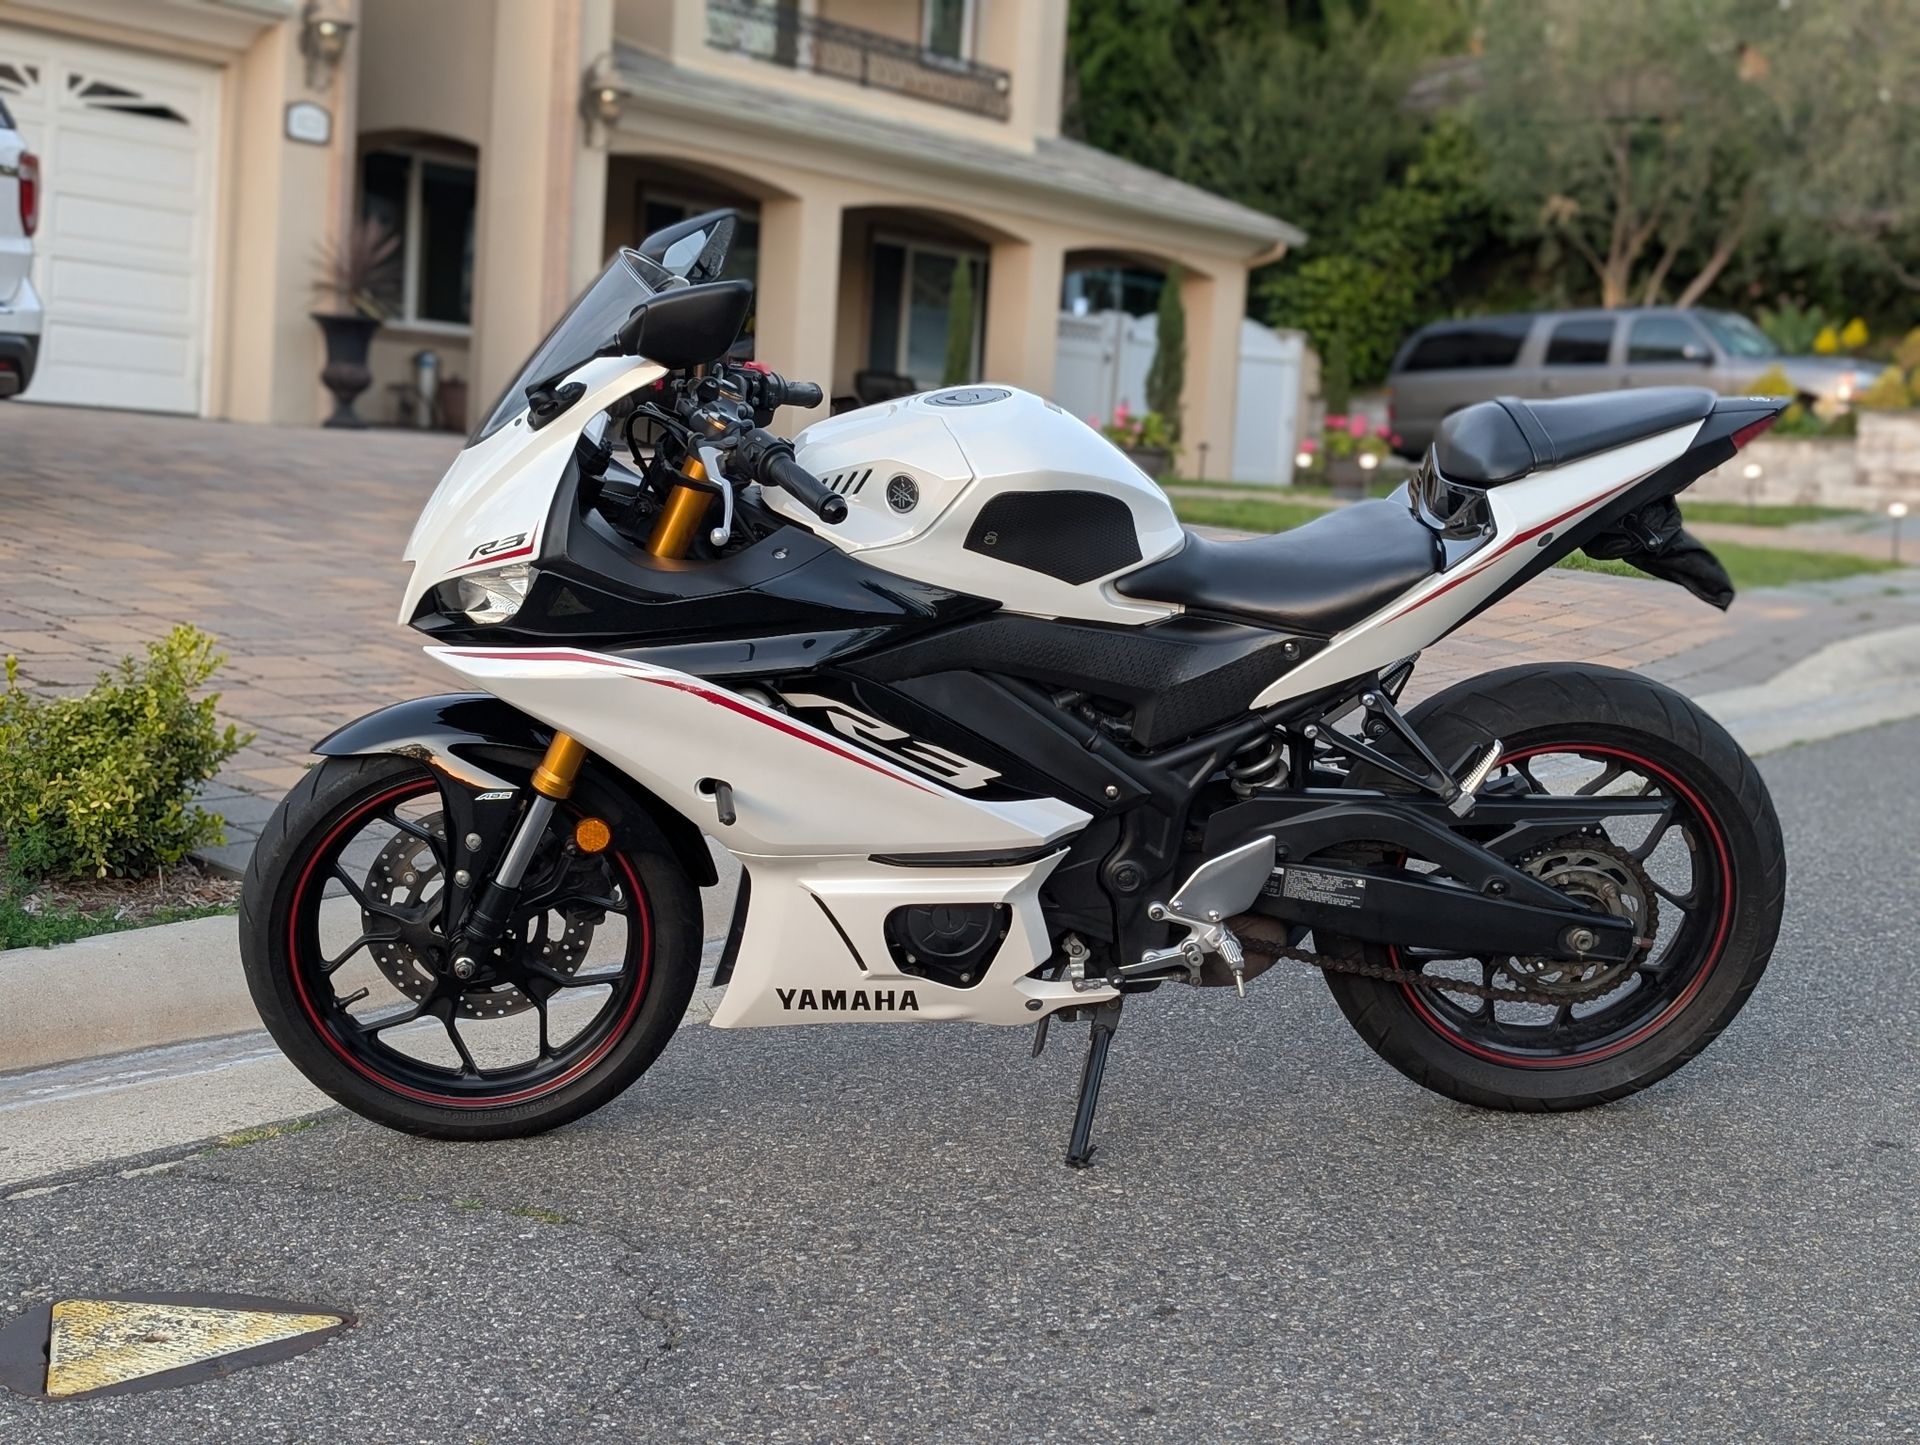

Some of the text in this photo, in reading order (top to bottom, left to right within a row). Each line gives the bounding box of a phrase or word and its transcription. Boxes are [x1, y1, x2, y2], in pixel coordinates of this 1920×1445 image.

[468, 532, 528, 560] R3
[779, 693, 1003, 790] R3
[775, 988, 920, 1011] YAMAHA
